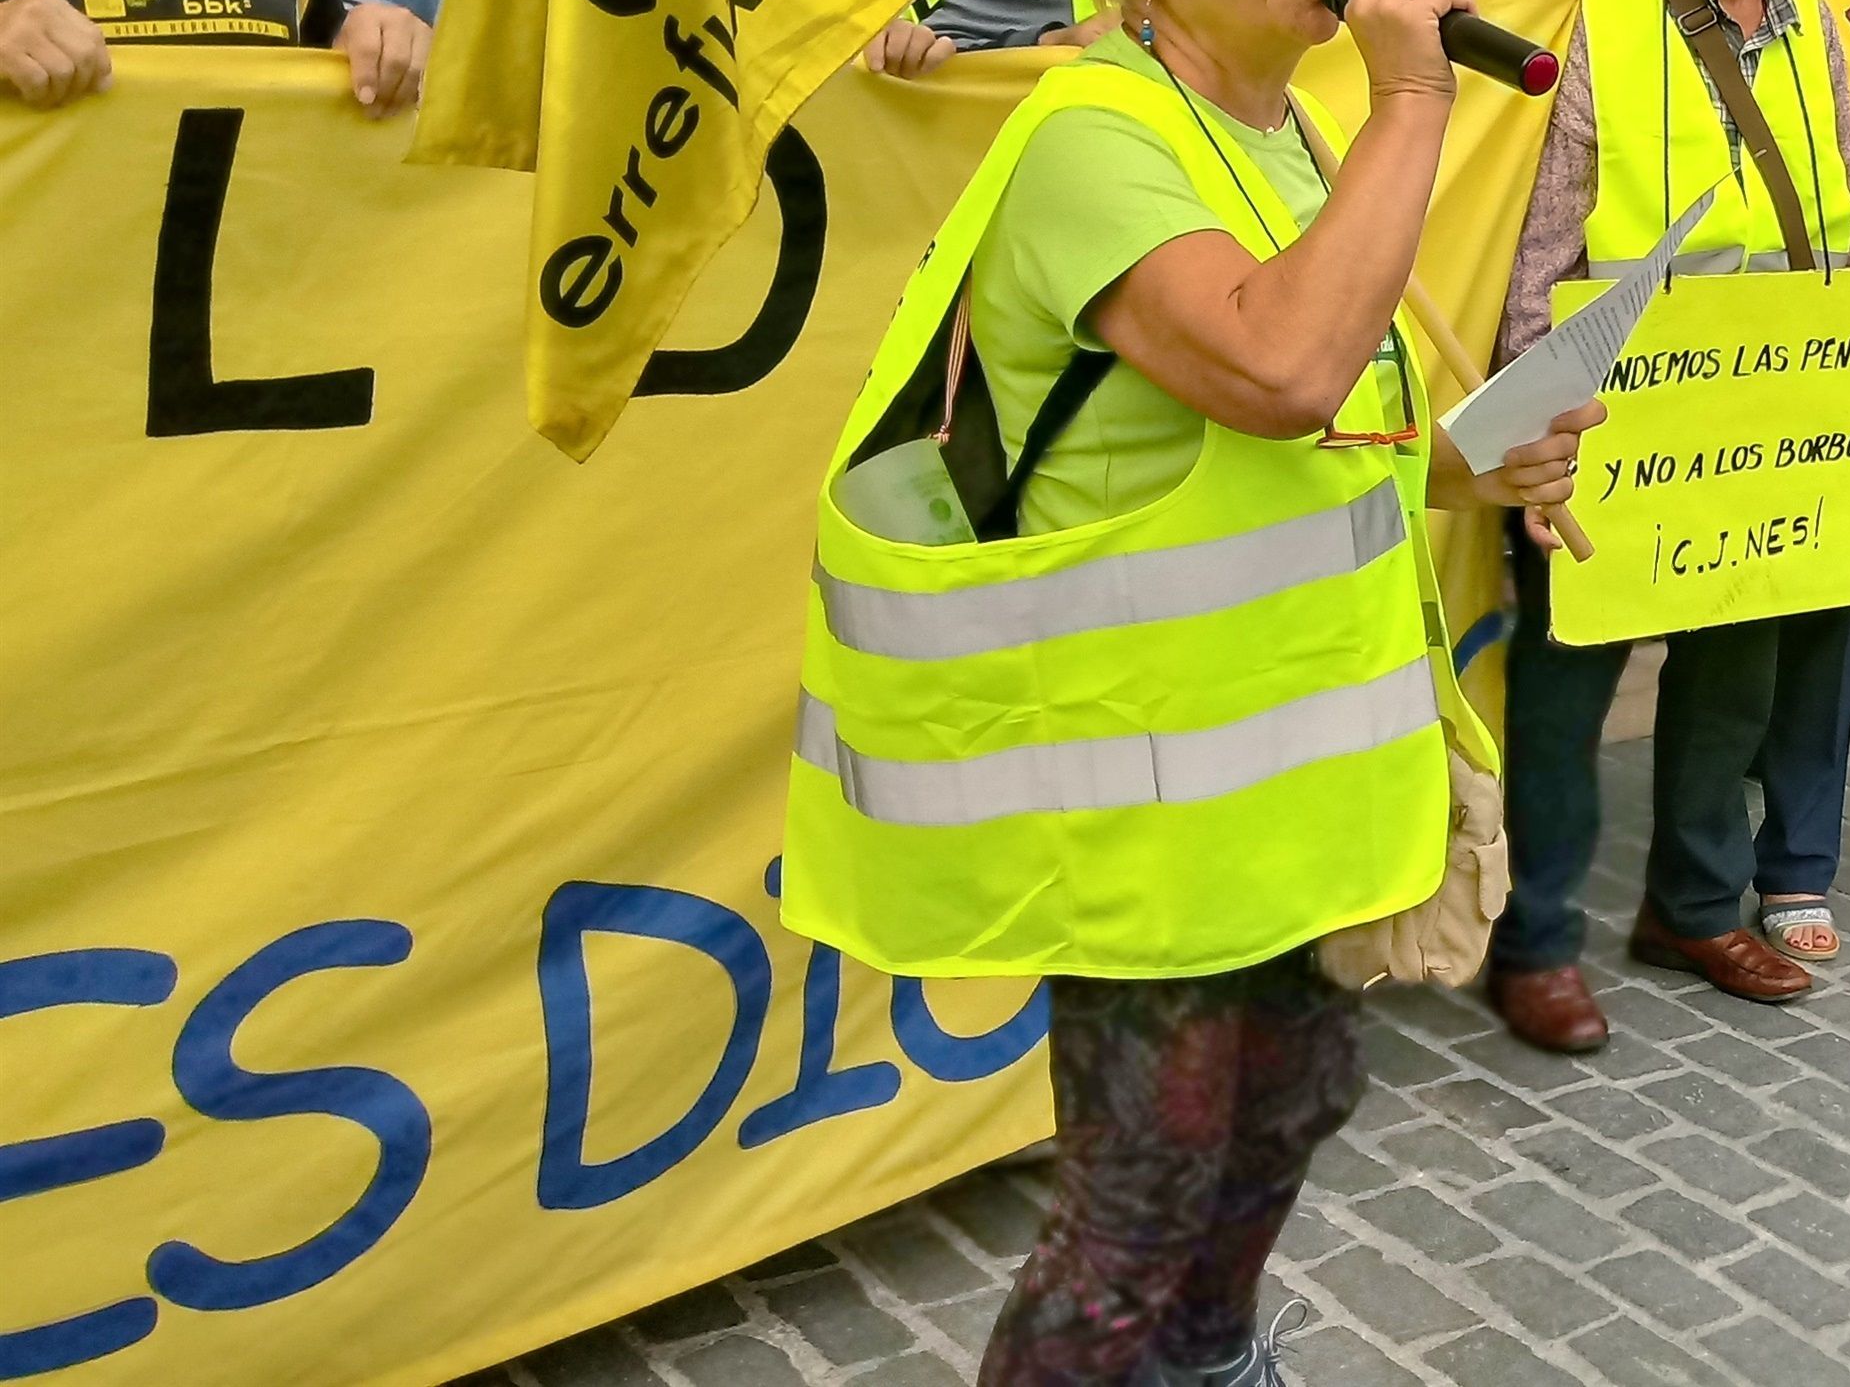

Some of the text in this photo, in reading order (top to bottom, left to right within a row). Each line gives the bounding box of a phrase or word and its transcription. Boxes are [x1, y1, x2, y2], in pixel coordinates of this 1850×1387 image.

[1734, 343, 1789, 376] LAS
[1599, 460, 1621, 503] Y
[1634, 458, 1676, 491] NO
[1685, 453, 1704, 483] A
[1713, 445, 1763, 477] LOS
